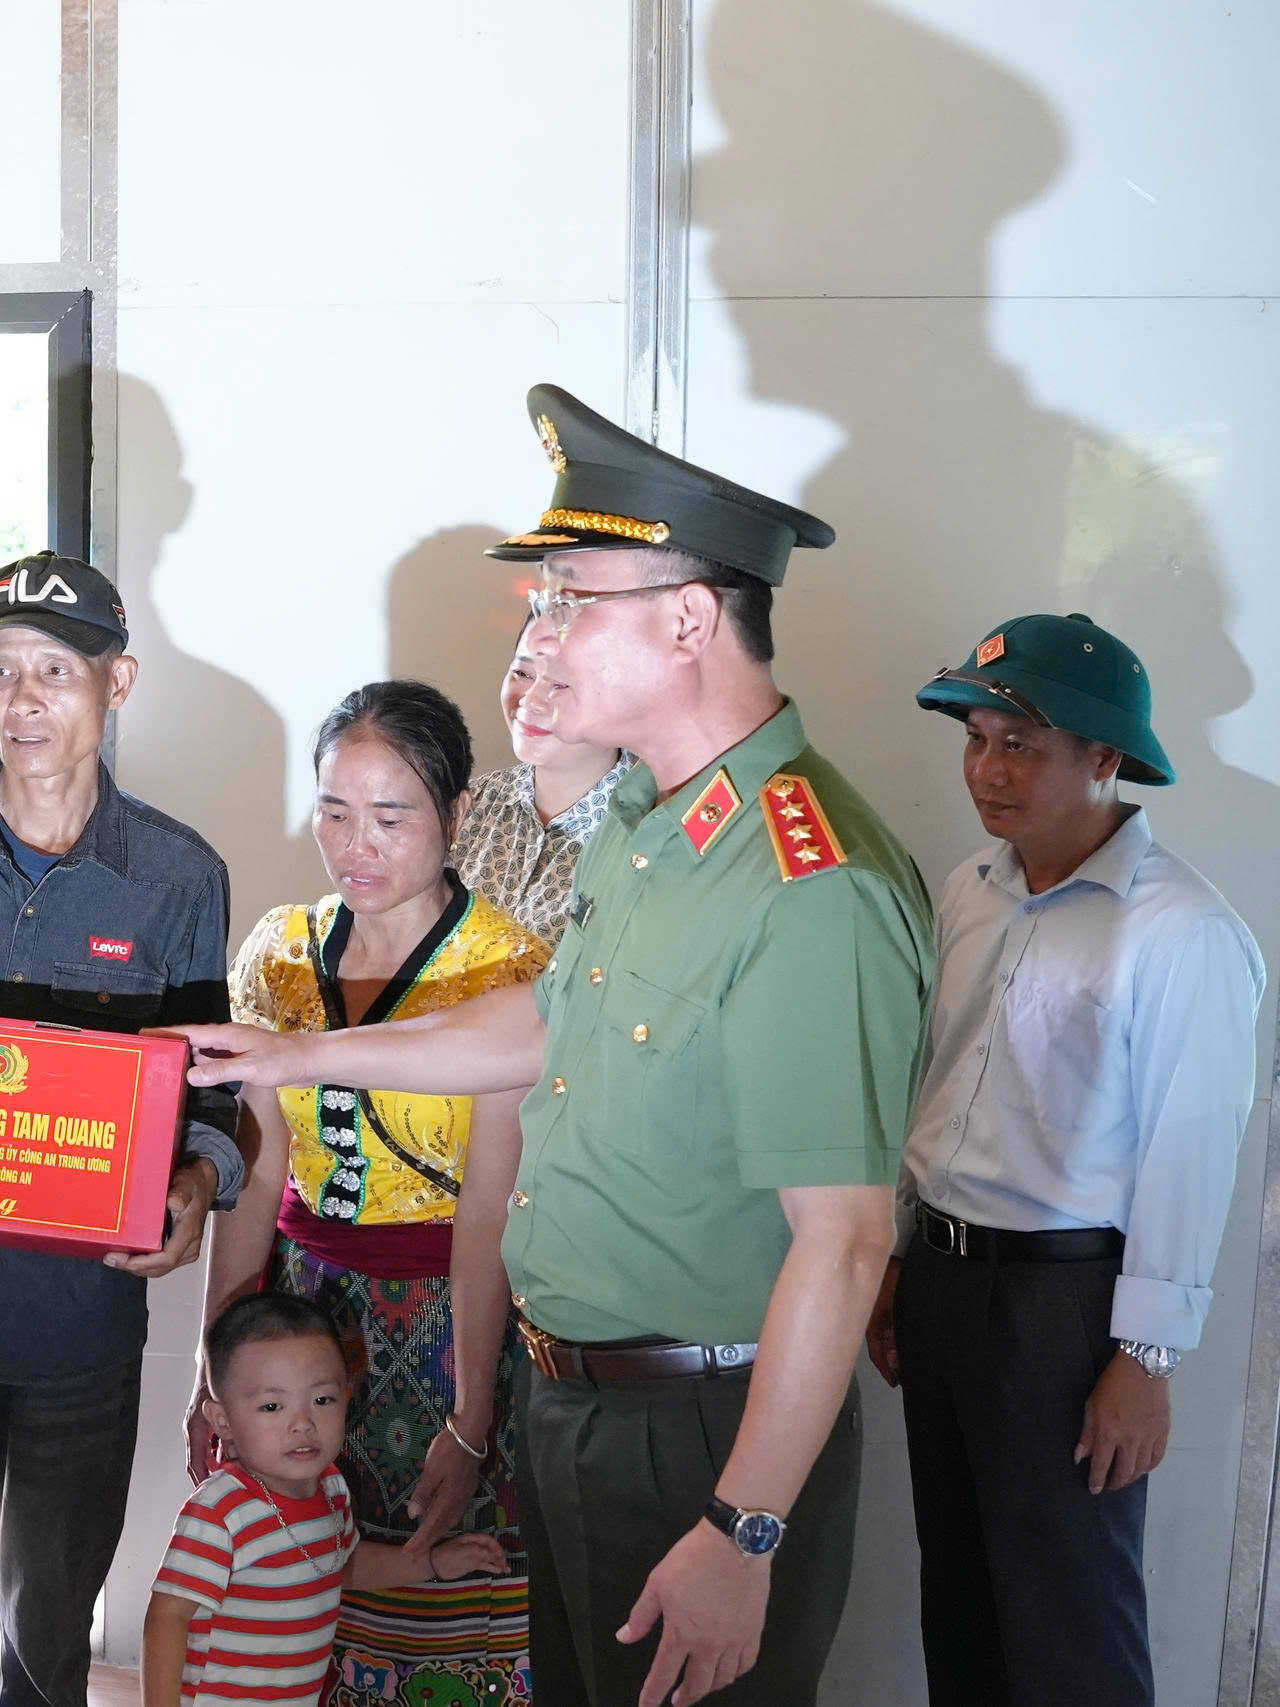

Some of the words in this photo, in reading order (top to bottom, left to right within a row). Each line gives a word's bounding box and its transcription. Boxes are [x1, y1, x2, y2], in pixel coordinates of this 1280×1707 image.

[12, 1110, 50, 1142] TAM
[53, 1115, 117, 1150] QUANG
[19, 1147, 42, 1165] CÔNG
[44, 1152, 57, 1167] AN
[58, 1153, 86, 1171] TRUNG
[87, 1156, 111, 1173] ƯƠNG
[19, 1171, 33, 1185] AN
